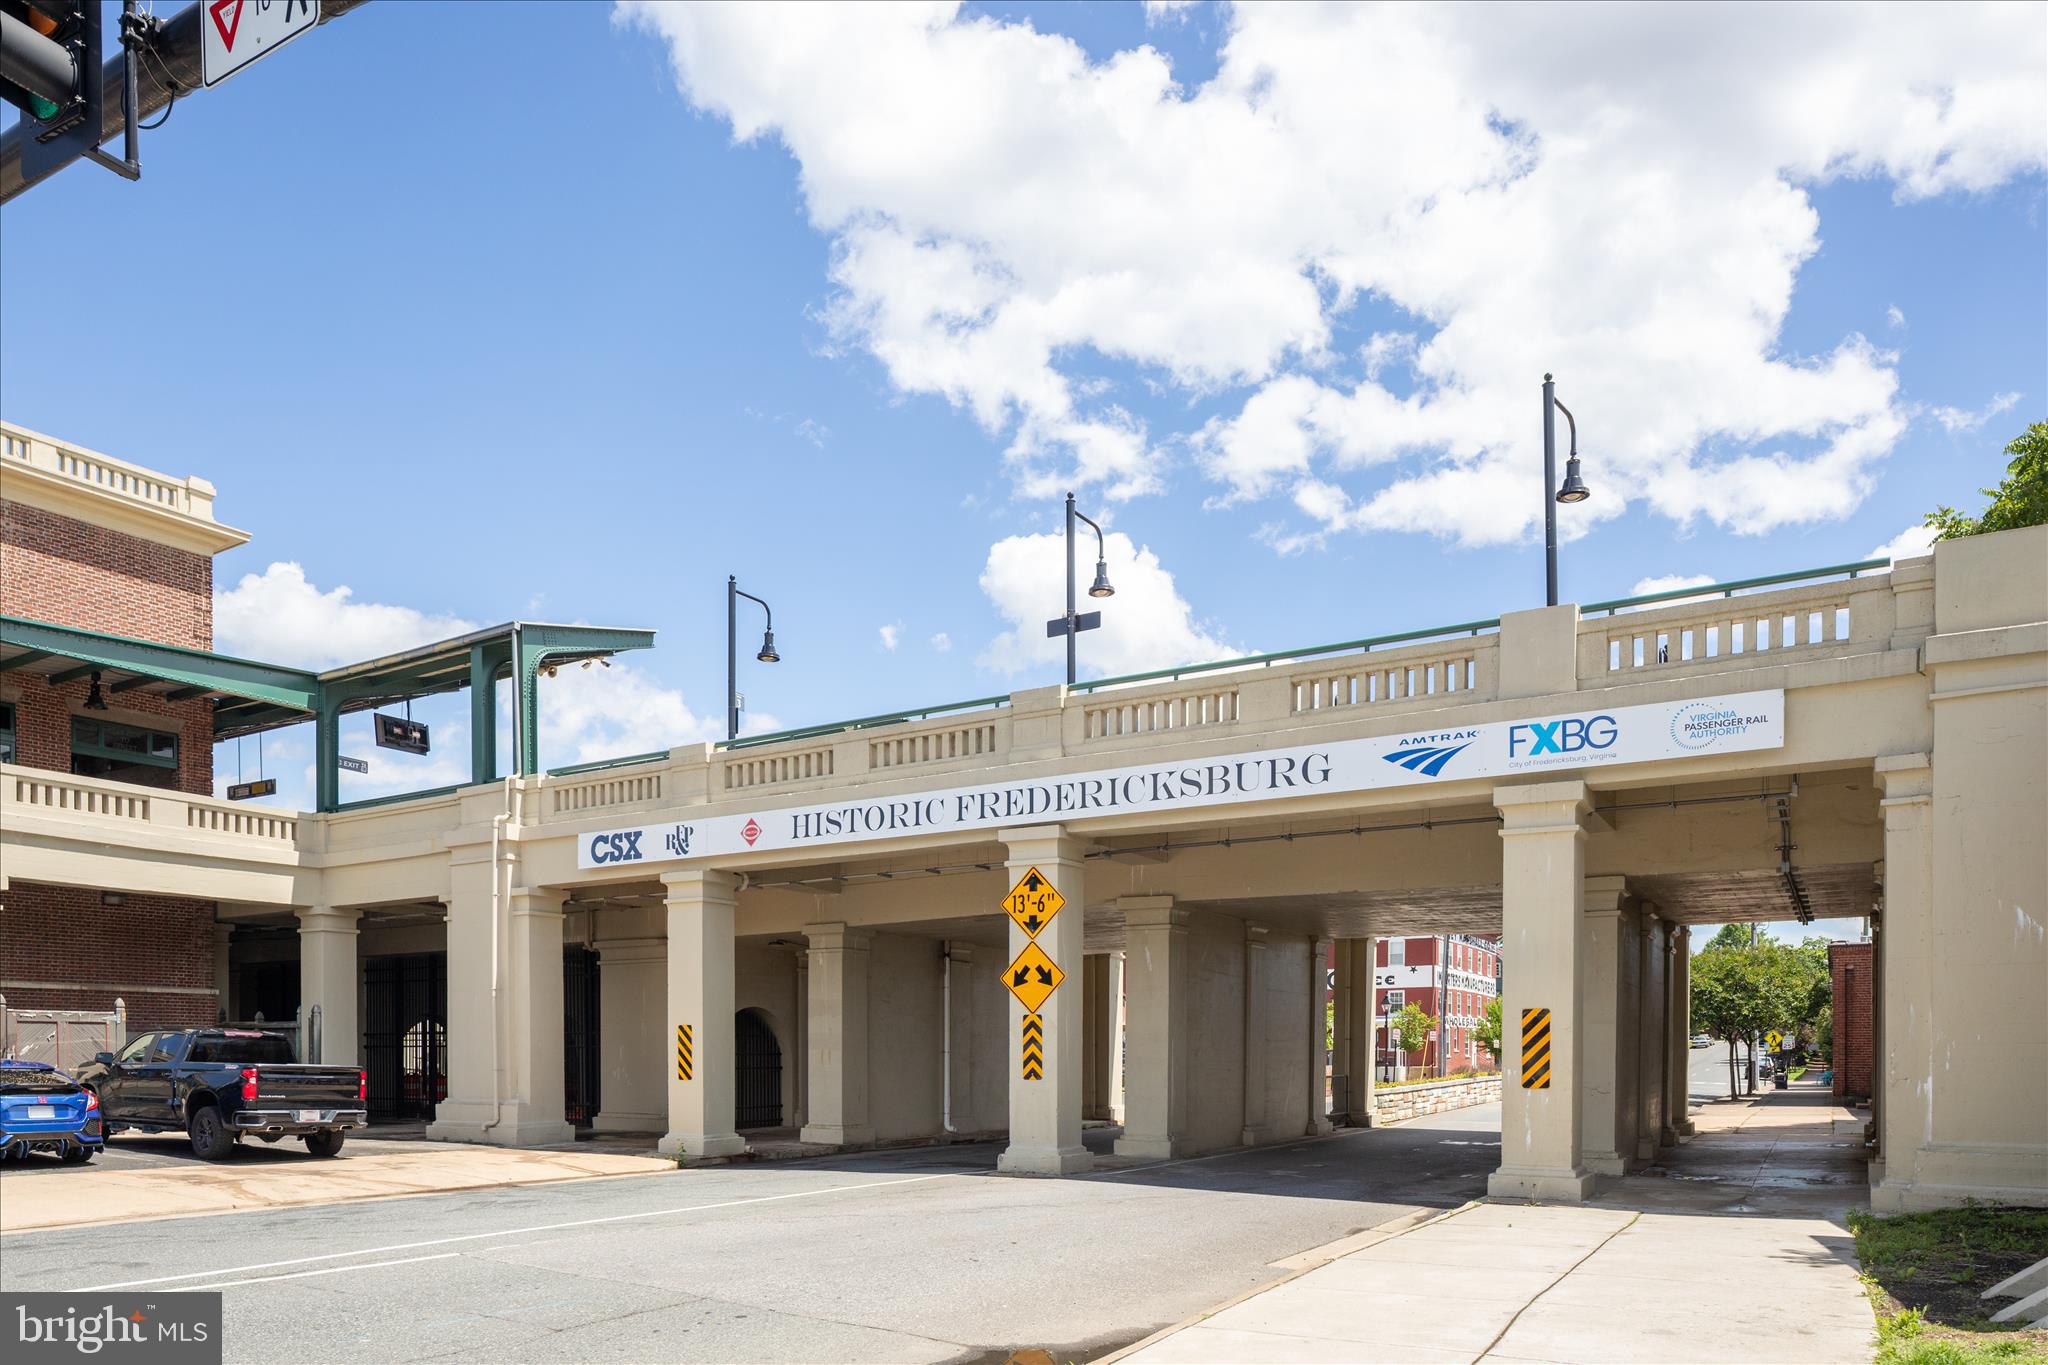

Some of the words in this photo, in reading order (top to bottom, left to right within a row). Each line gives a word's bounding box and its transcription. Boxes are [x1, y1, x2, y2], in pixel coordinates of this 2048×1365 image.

[1684, 717, 1743, 732] PASSENGER
[1746, 715, 1769, 725] RAIL
[1690, 710, 1737, 722] VIRGINIA
[1399, 730, 1478, 746] AMTRAK
[1509, 715, 1618, 758] FXBG
[1689, 725, 1748, 739] AUTHORITY
[344, 760, 359, 769] EXIT
[1589, 752, 1617, 761] Virginia
[791, 797, 945, 839] HISTORIC
[955, 752, 1334, 822] FREDERICKSBURG
[591, 830, 643, 864] CSX
